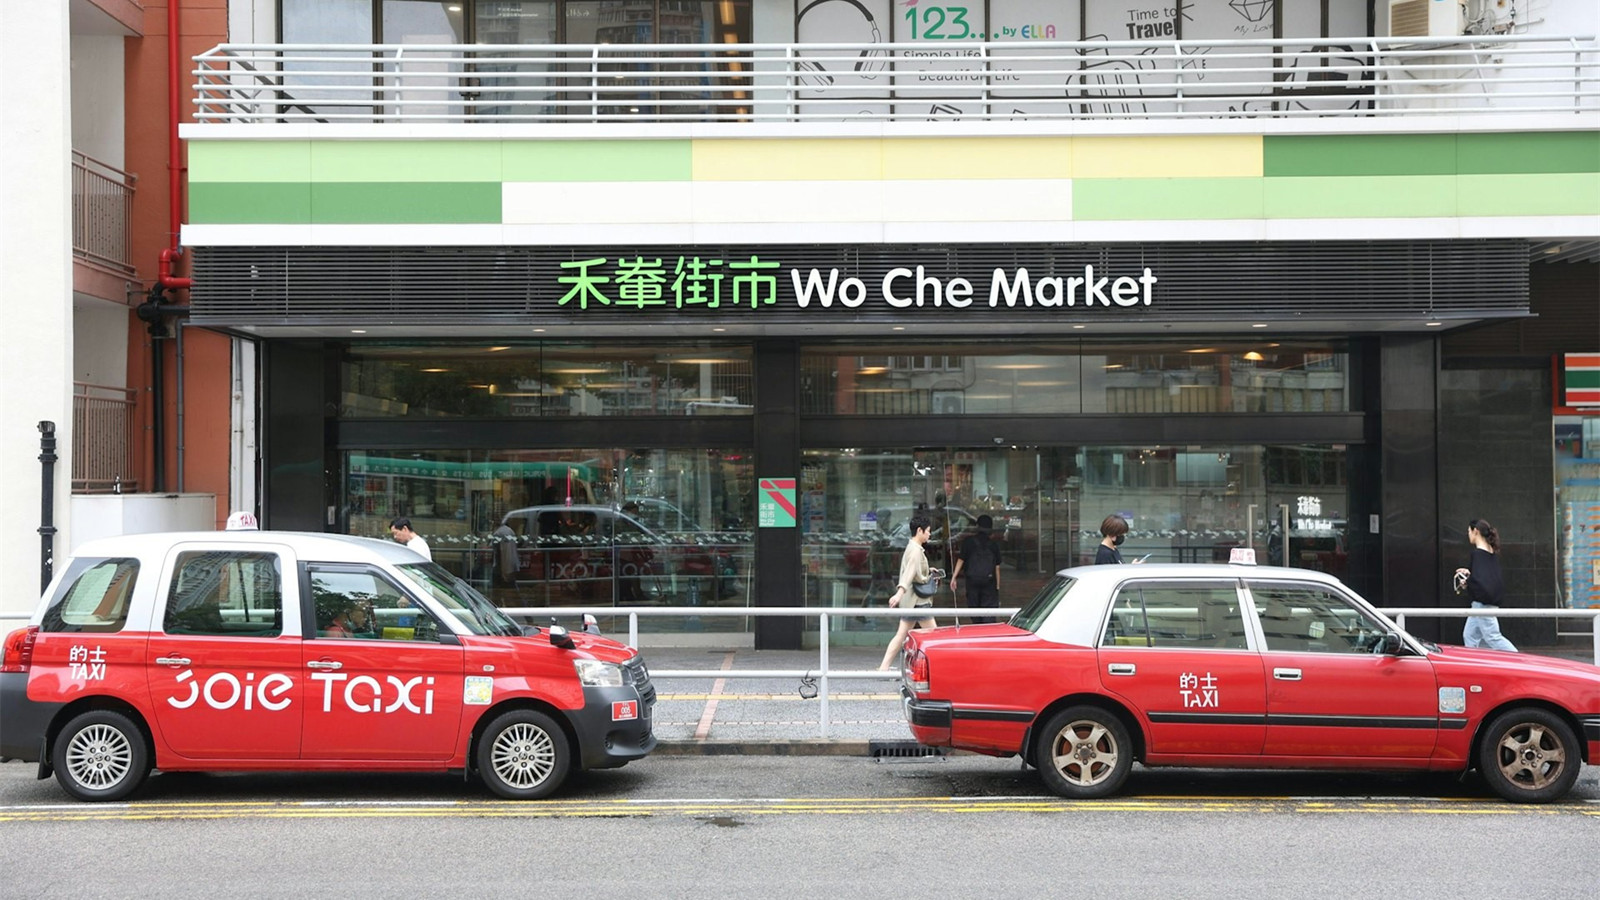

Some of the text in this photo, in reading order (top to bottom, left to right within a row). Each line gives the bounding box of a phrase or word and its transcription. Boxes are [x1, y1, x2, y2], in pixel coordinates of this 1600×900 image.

[1127, 8, 1178, 21] Time to
[1002, 26, 1017, 37] by
[1021, 24, 1056, 38] ELLA
[1126, 19, 1178, 40] Travel
[1234, 24, 1248, 36] My
[558, 255, 781, 309] 禾輋街市
[790, 264, 1158, 308] Wo Che Market
[241, 514, 256, 528] TAXI
[69, 645, 107, 662] 的士
[69, 663, 106, 680] TAXI
[1180, 672, 1217, 689] 的士
[1180, 690, 1218, 707] TAXI
